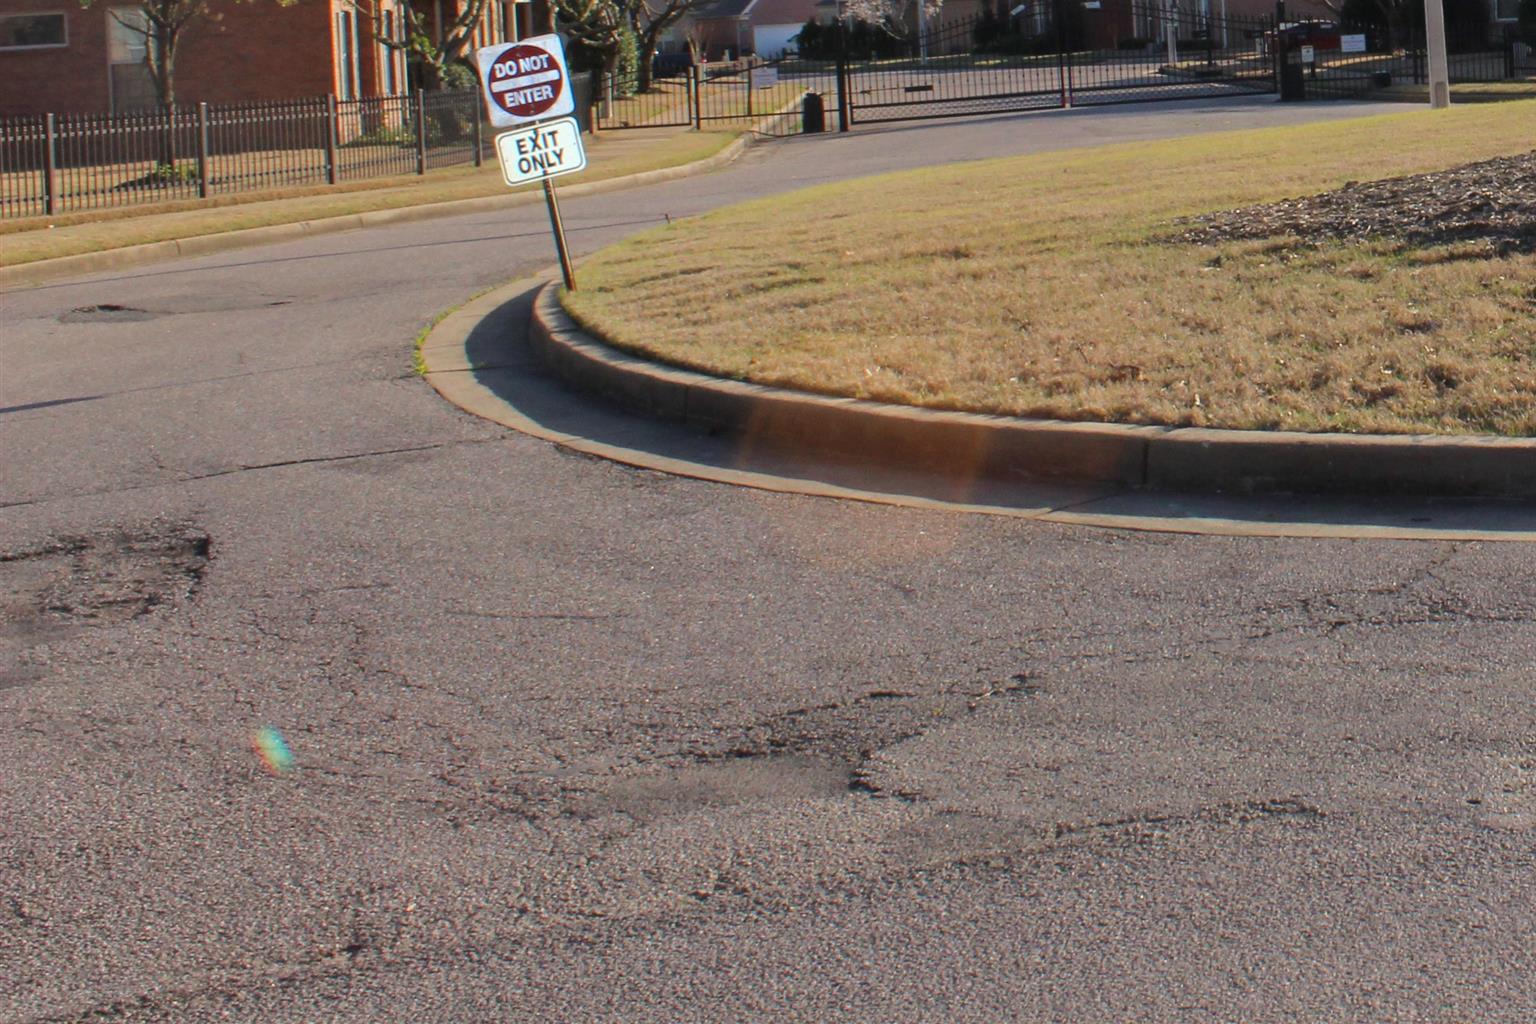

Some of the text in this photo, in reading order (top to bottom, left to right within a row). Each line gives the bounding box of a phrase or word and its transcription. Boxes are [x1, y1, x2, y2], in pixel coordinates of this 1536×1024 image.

[495, 54, 549, 78] DO NOT
[504, 85, 554, 108] ENTER
[516, 130, 558, 155] EXIT
[518, 148, 565, 174] ONLY
